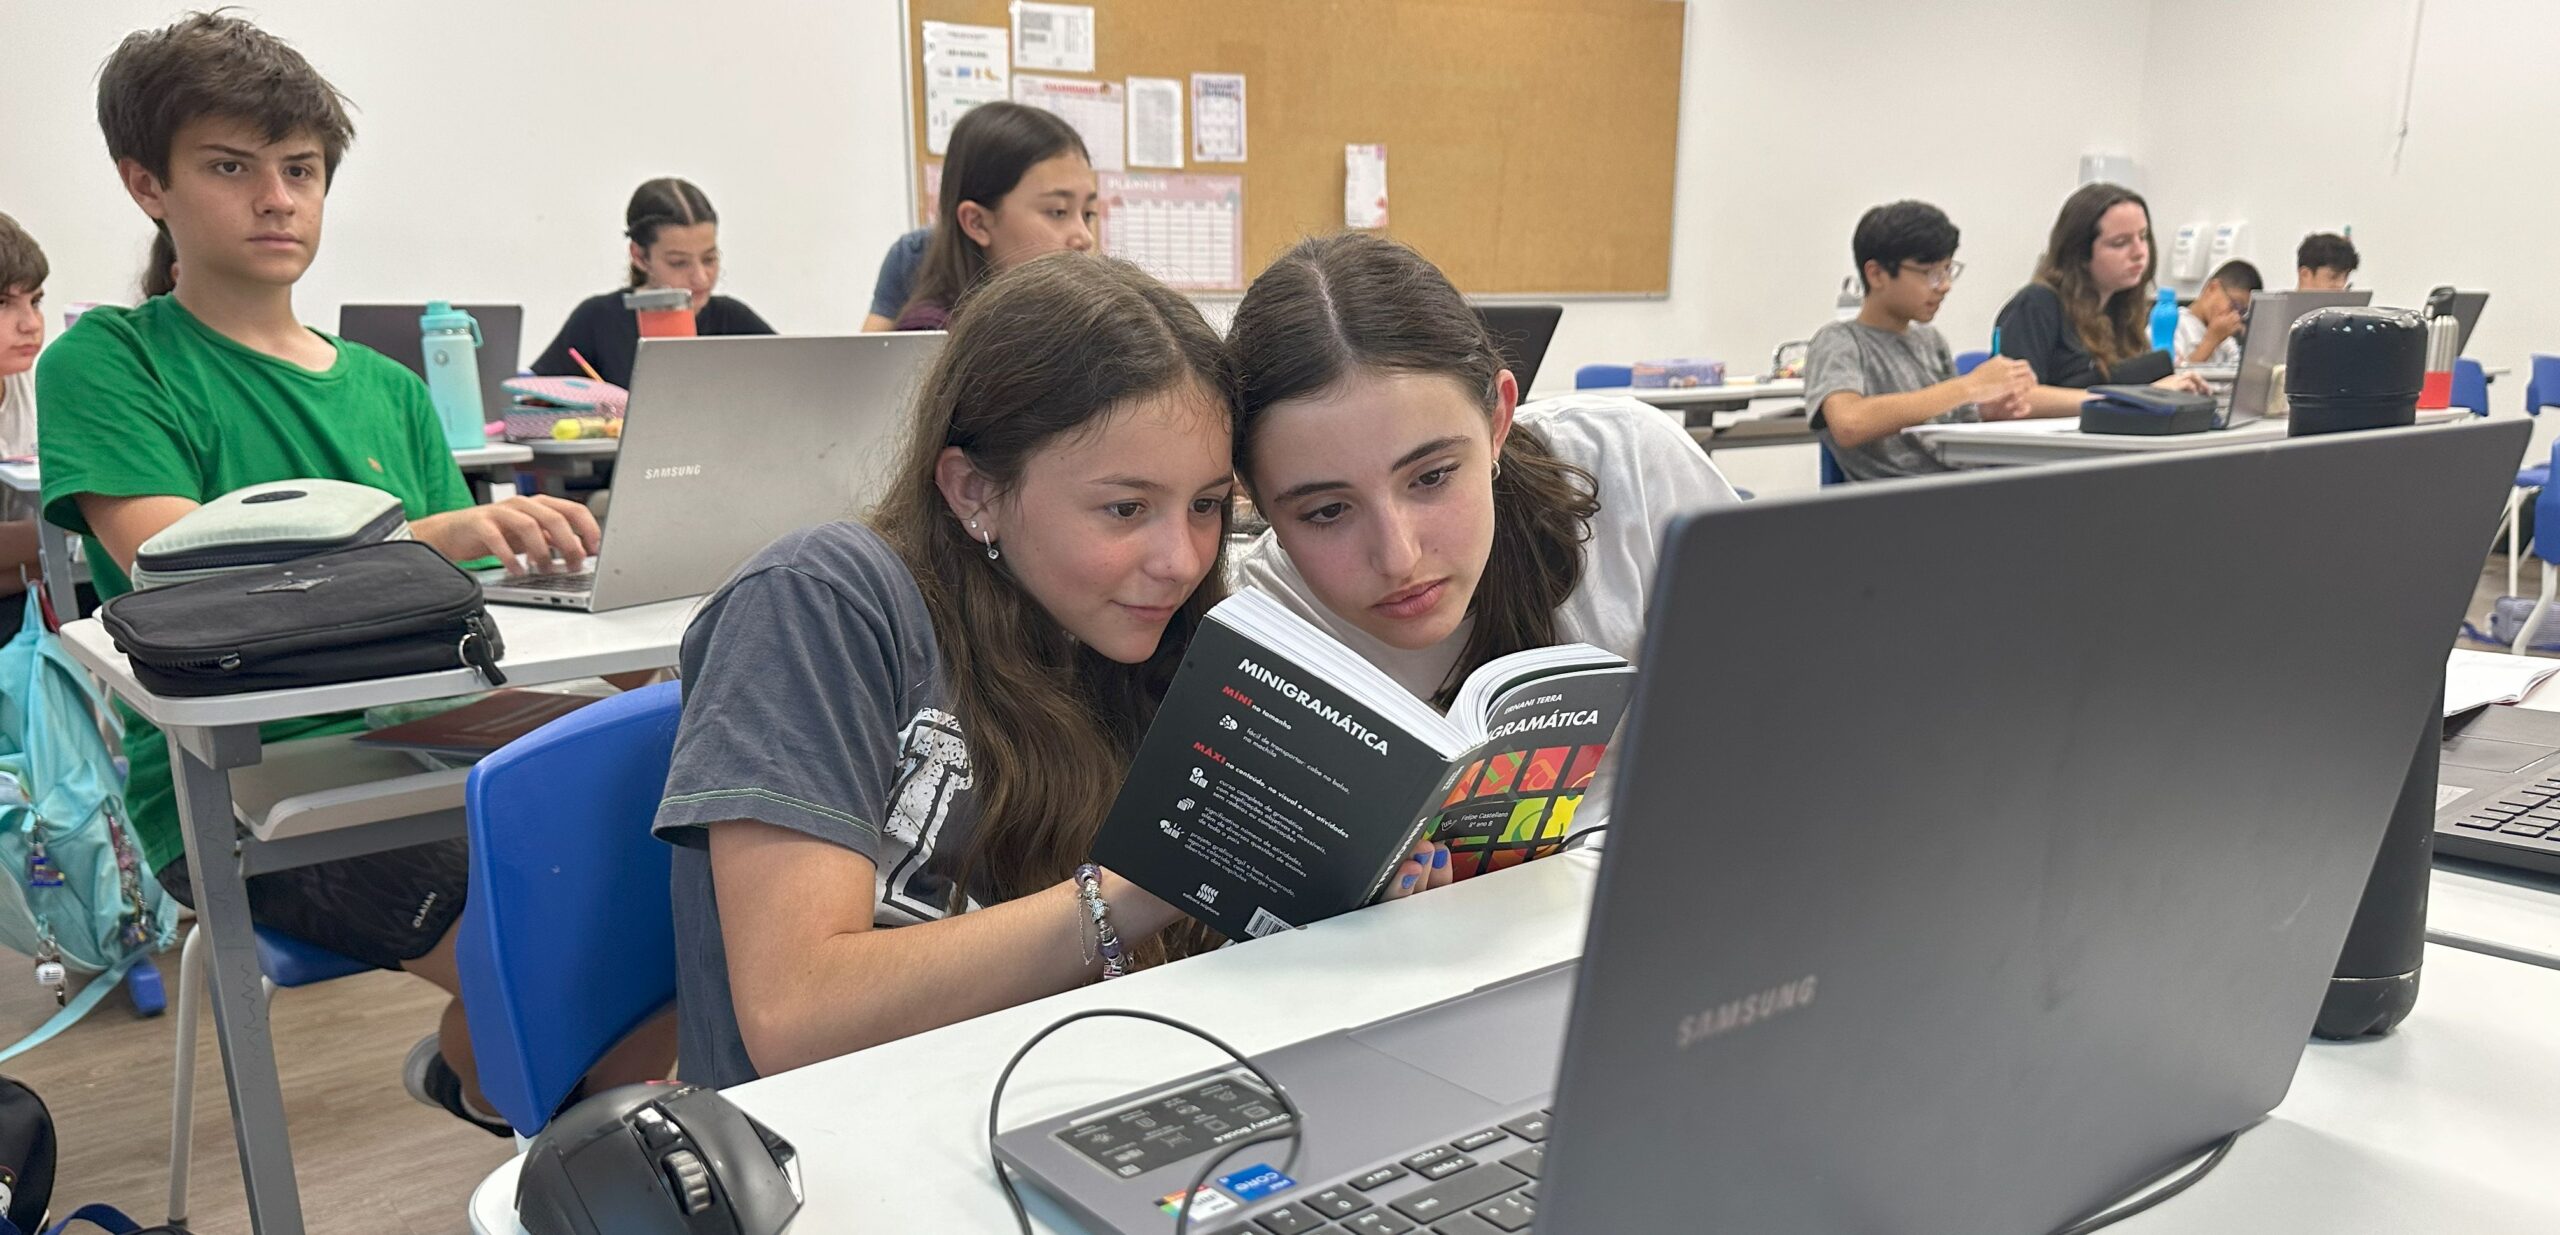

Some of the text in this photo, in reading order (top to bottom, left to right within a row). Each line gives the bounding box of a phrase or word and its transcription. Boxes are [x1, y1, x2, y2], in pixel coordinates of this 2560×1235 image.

[645, 464, 701, 480] SAMSUNG
[1238, 658, 1389, 756] MINIGRAMÁTICA
[1536, 693, 1563, 705] TERRA
[1262, 709, 1292, 730] tamanho
[1261, 737, 1270, 745] de
[1225, 762, 1235, 770] no
[1268, 786, 1277, 794] no
[1278, 792, 1298, 806] visual
[1303, 808, 1315, 817] nas
[1316, 816, 1349, 838] atividades
[1264, 805, 1273, 813] de
[1677, 974, 1818, 1050] SAMSUNG
